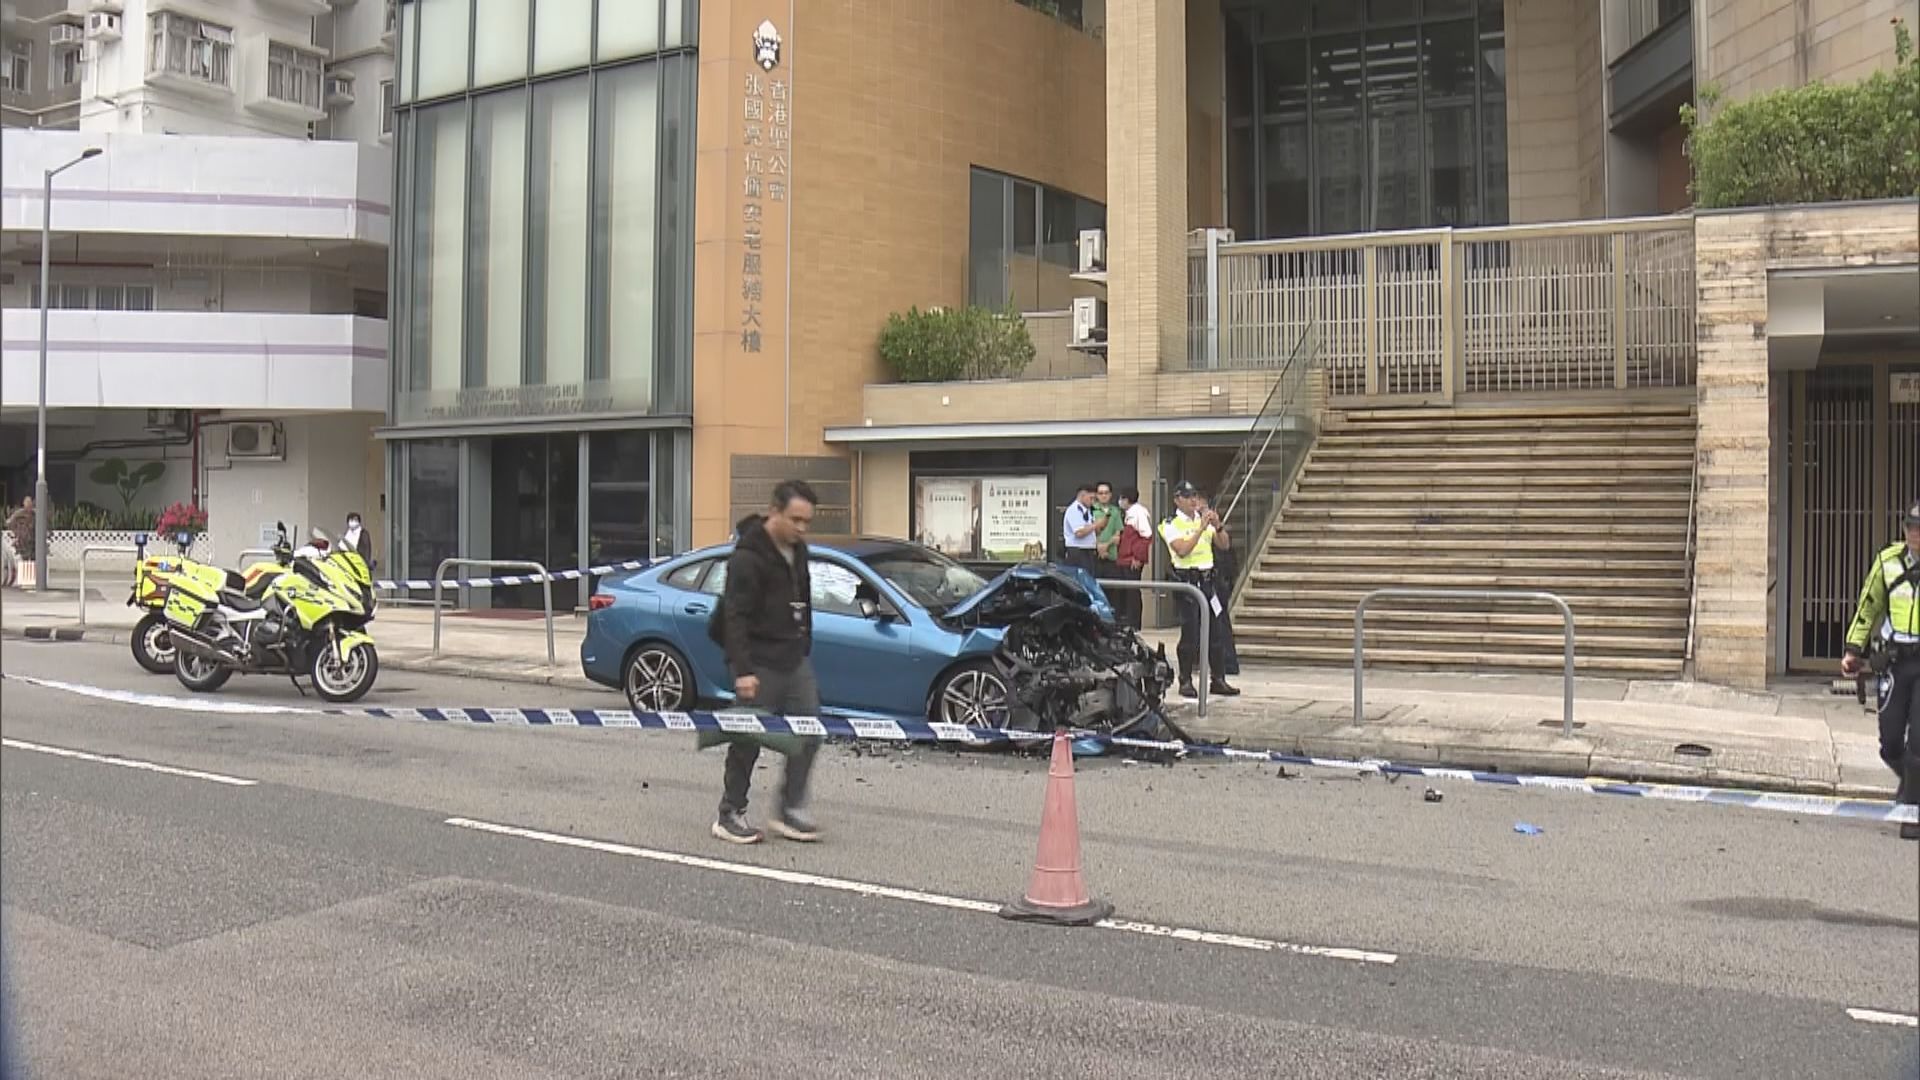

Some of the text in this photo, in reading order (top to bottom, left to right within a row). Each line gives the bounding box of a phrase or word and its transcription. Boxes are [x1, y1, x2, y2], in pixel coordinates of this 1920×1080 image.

[767, 80, 787, 200] 香港聖公會
